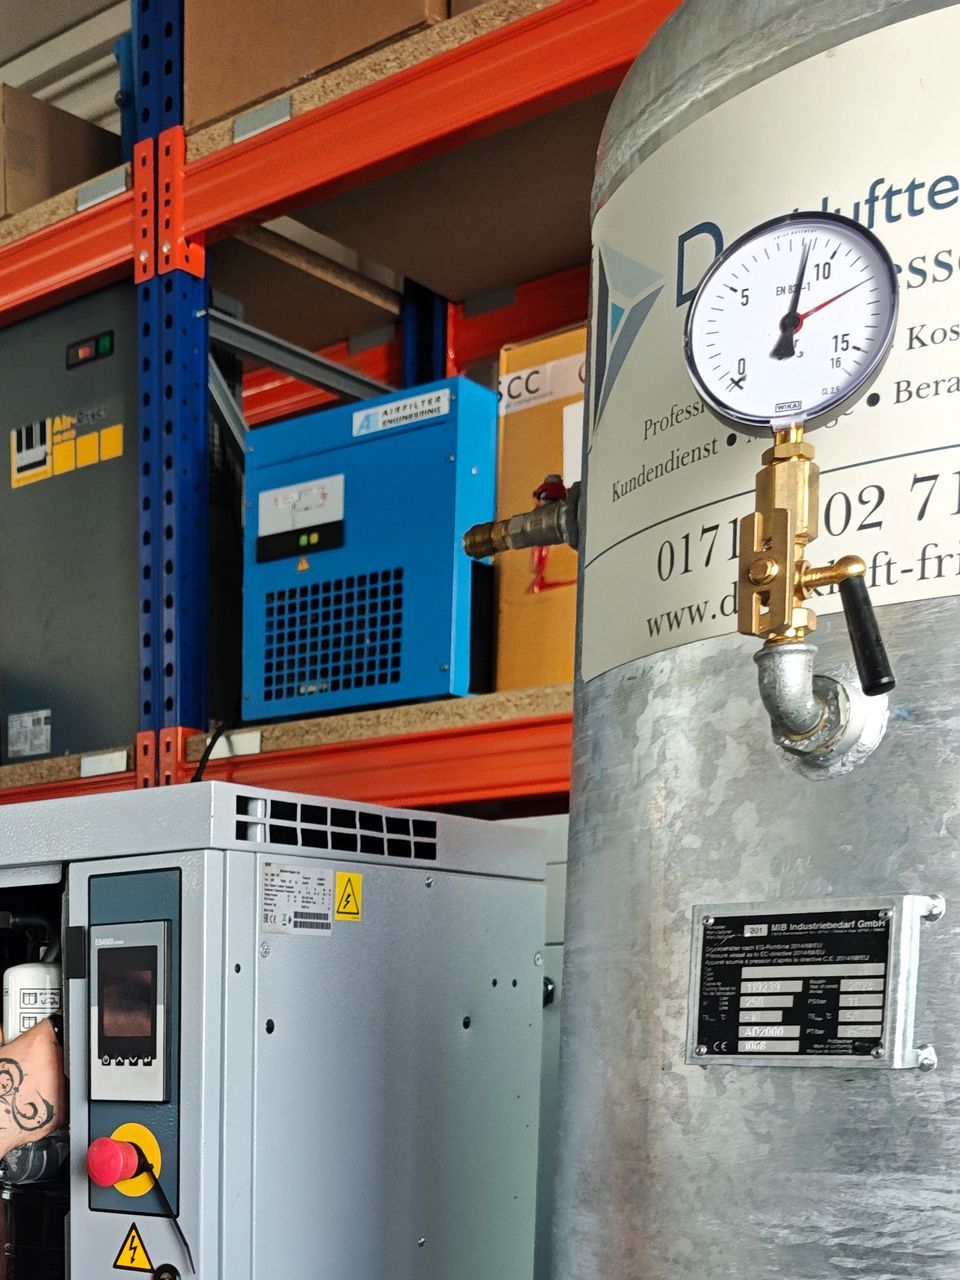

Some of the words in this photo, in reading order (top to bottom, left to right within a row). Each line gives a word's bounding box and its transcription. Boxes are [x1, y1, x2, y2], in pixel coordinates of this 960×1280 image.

[814, 262, 831, 281] 10
[740, 288, 749, 306] 5
[776, 286, 786, 296] EN
[832, 333, 850, 353] 15
[738, 358, 746, 375] 0
[830, 357, 842, 369] 16
[612, 437, 718, 503] Kundendienst
[657, 517, 740, 582] 0171
[790, 920, 855, 930] Industriebedarf
[857, 919, 886, 928] GmbH
